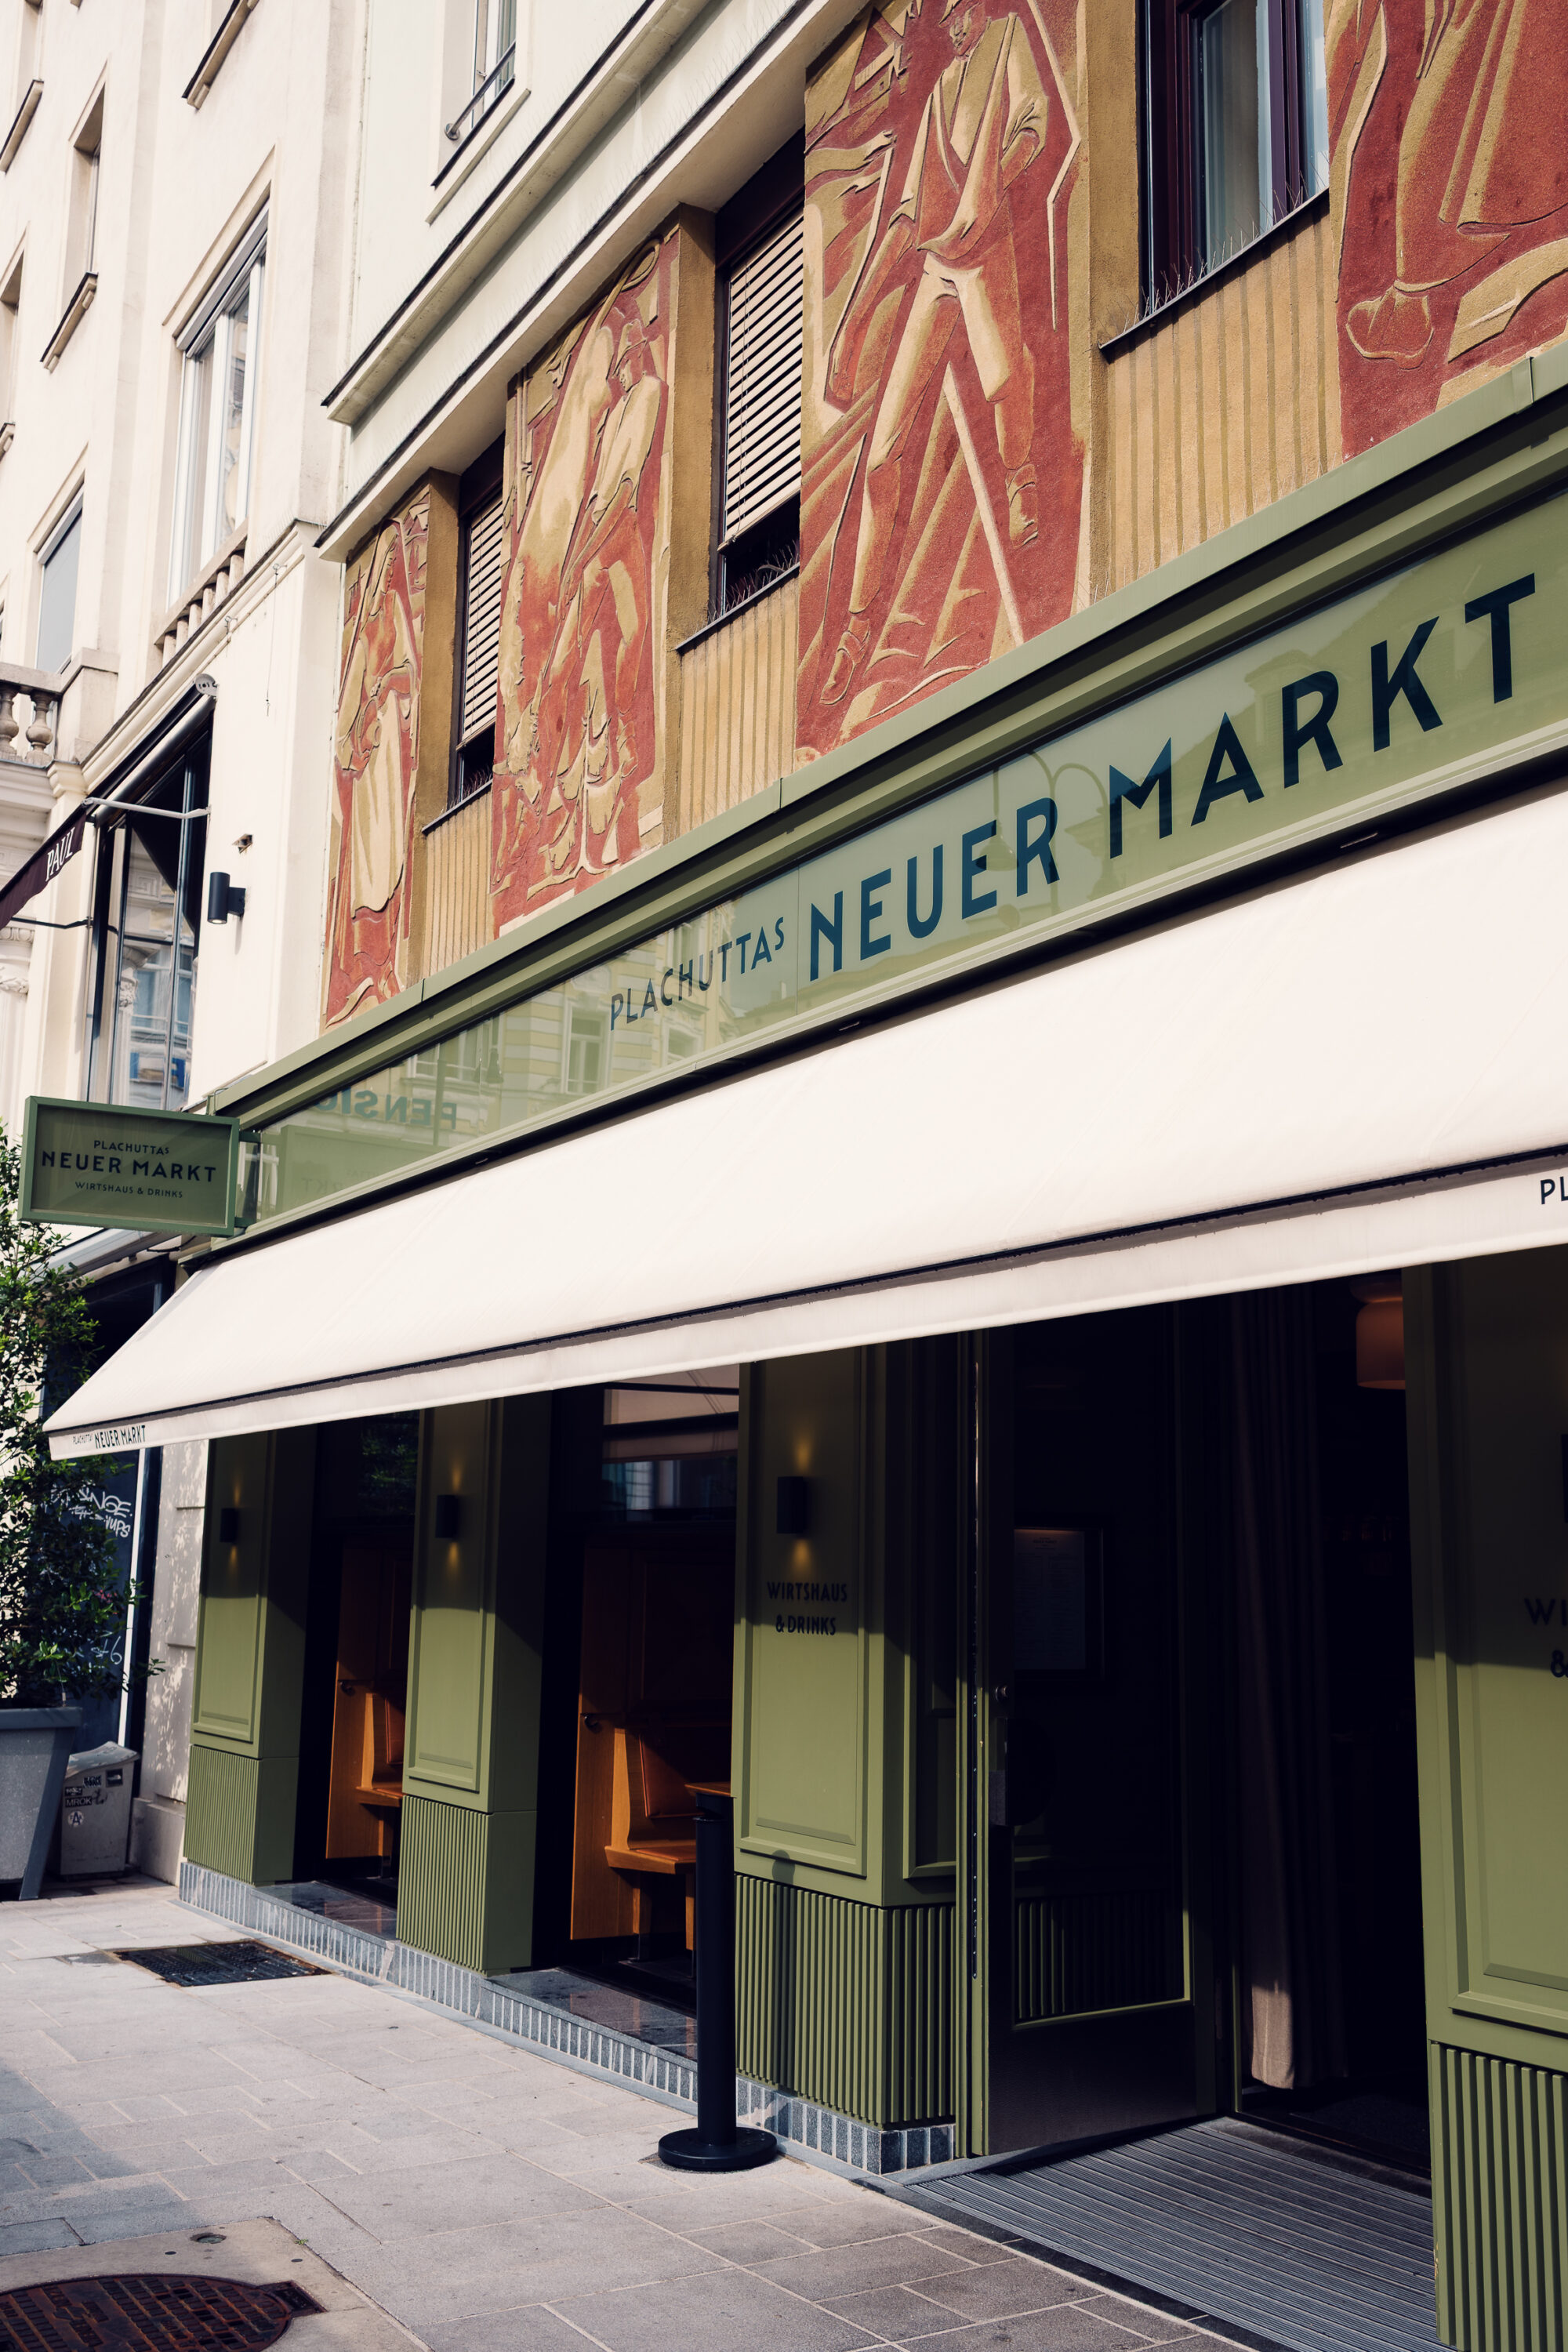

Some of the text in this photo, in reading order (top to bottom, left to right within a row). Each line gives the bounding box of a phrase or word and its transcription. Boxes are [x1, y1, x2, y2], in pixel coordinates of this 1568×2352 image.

[611, 572, 1536, 1031] PLACHUTTAS NEUER MARKT
[45, 826, 75, 882] PAUL
[93, 1140, 169, 1156] PLACHUTTAS
[42, 1150, 216, 1182] NEUER MARKT
[74, 1181, 183, 1199] WIRTSHAUS & DRINKS
[94, 1428, 121, 1449] NEUER
[120, 1425, 146, 1445] MARKT
[767, 1581, 848, 1602] WIRTSHAUS
[775, 1614, 837, 1636] & DRINKS
